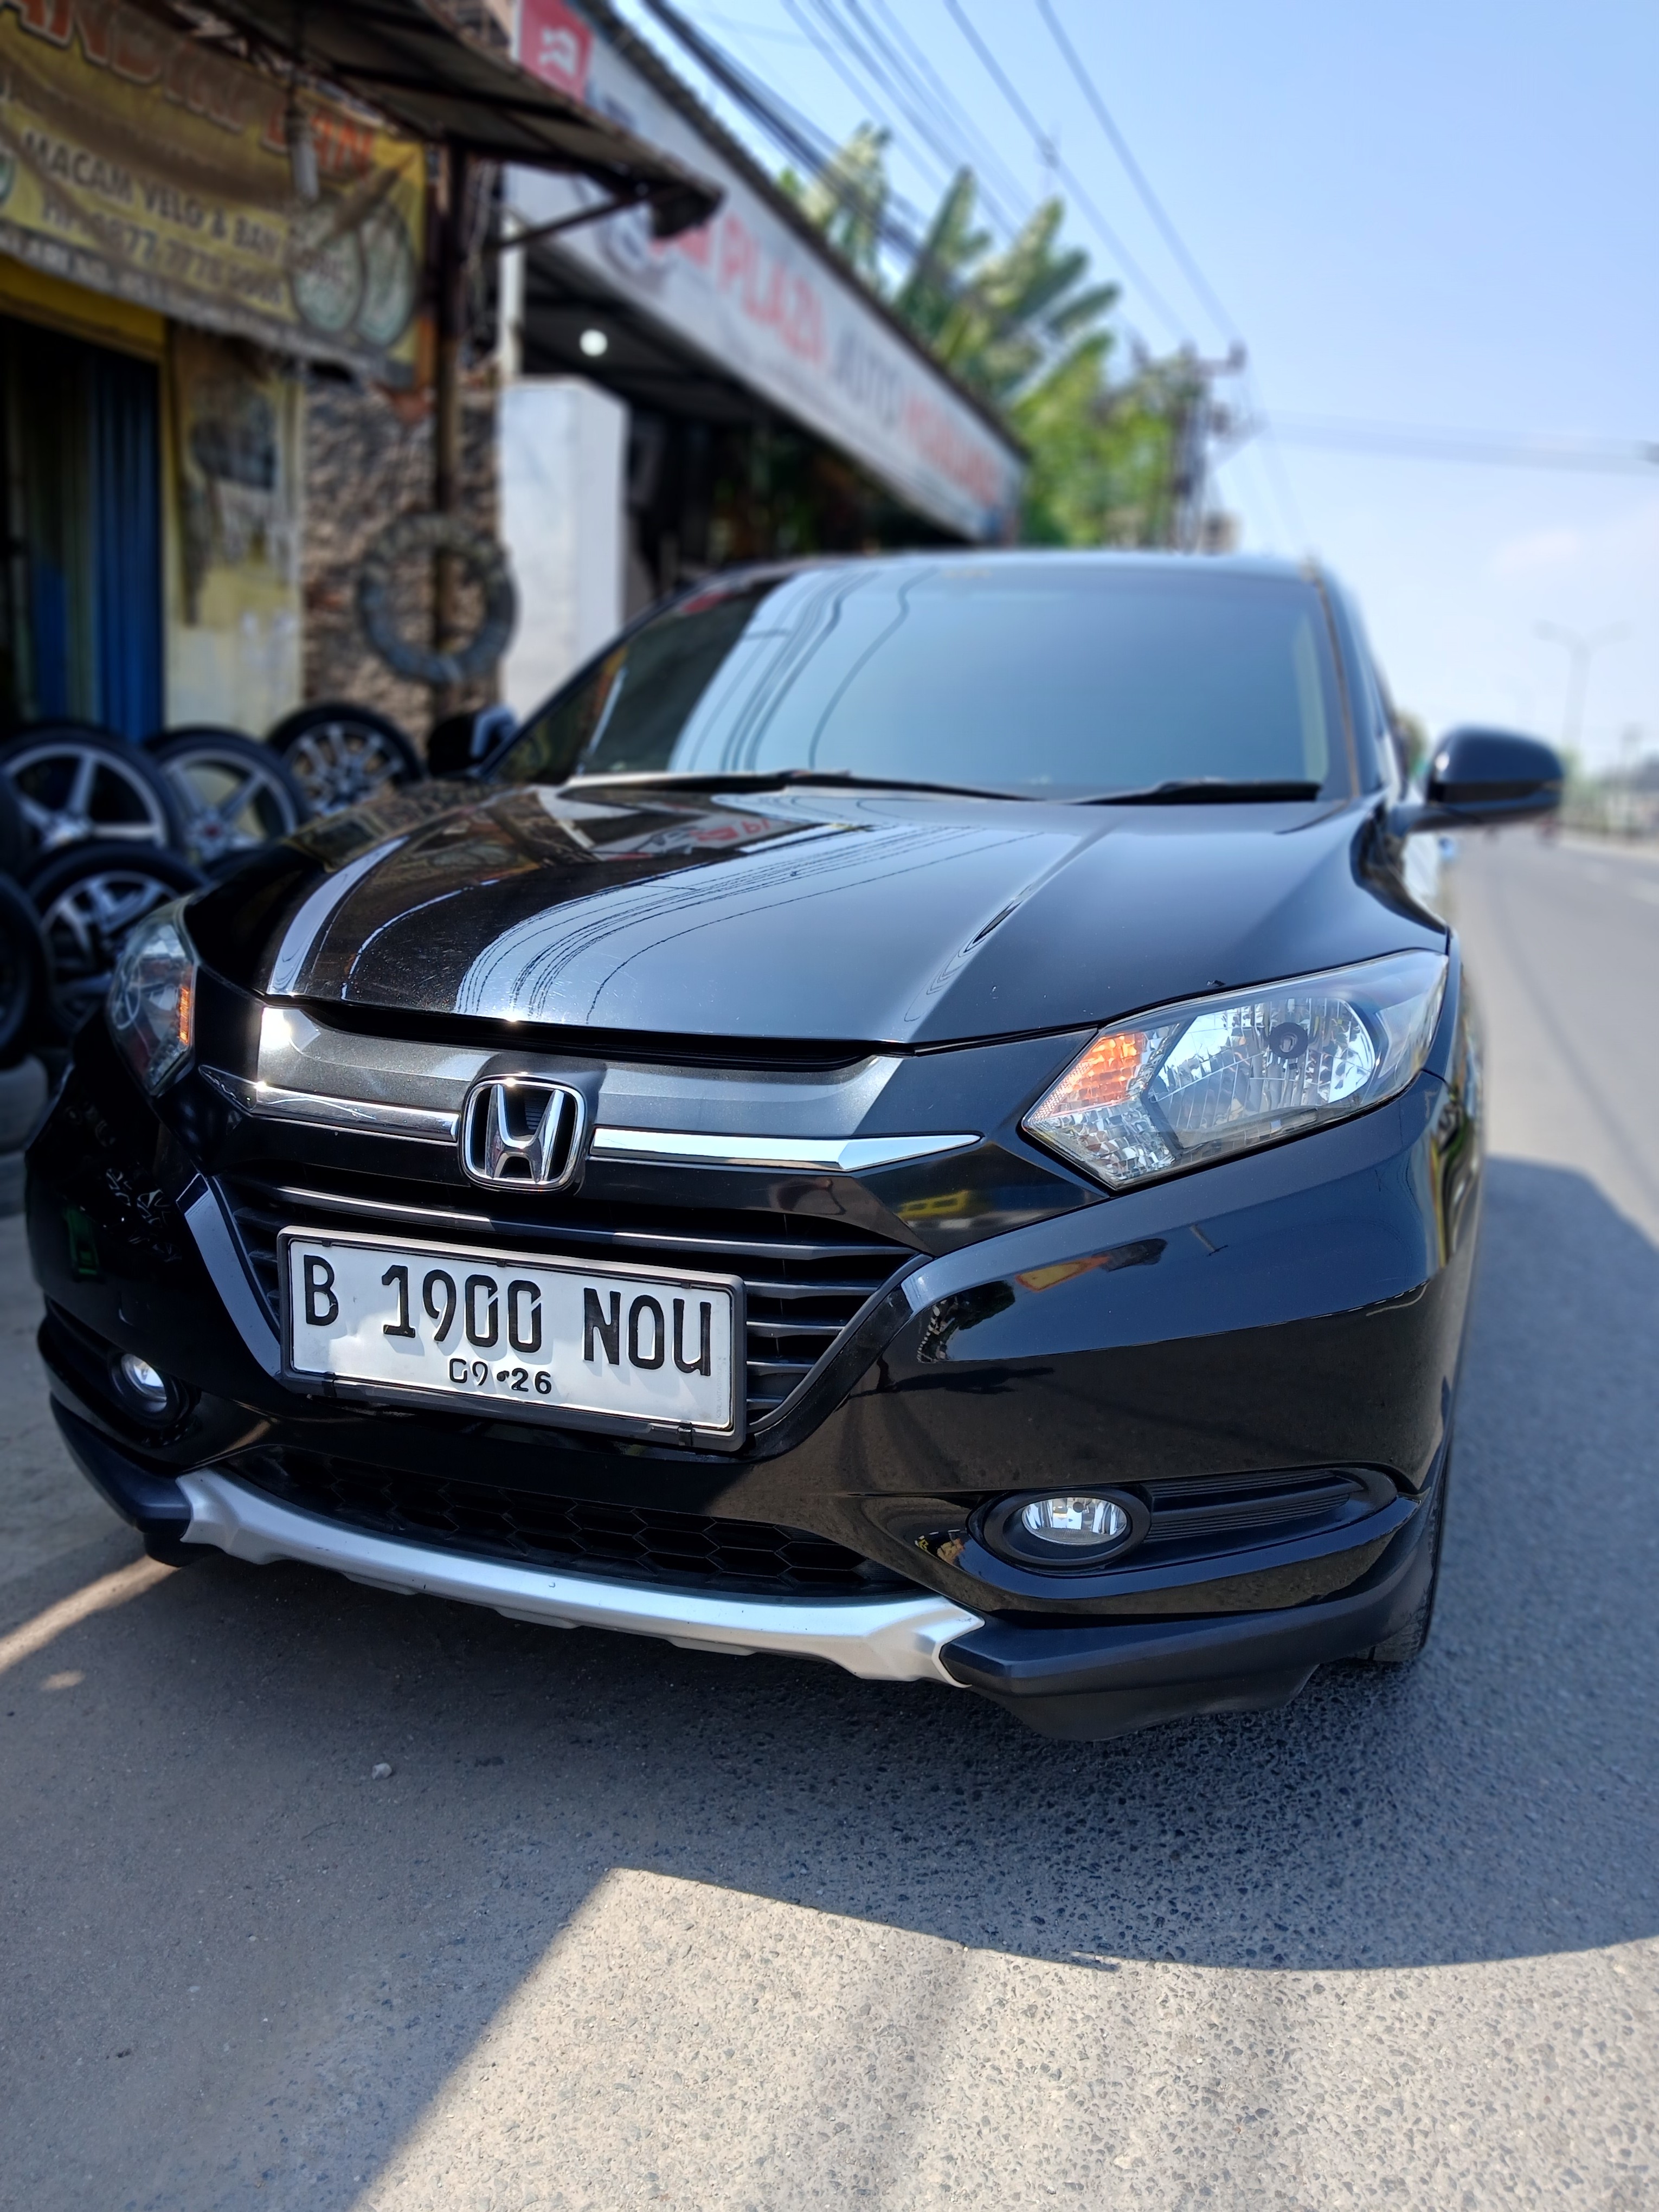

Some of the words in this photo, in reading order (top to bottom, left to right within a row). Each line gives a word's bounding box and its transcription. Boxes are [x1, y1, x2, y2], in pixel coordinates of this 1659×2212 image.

[304, 1254, 338, 1326] B
[381, 1264, 542, 1353] 1900
[583, 1287, 711, 1377] NOU
